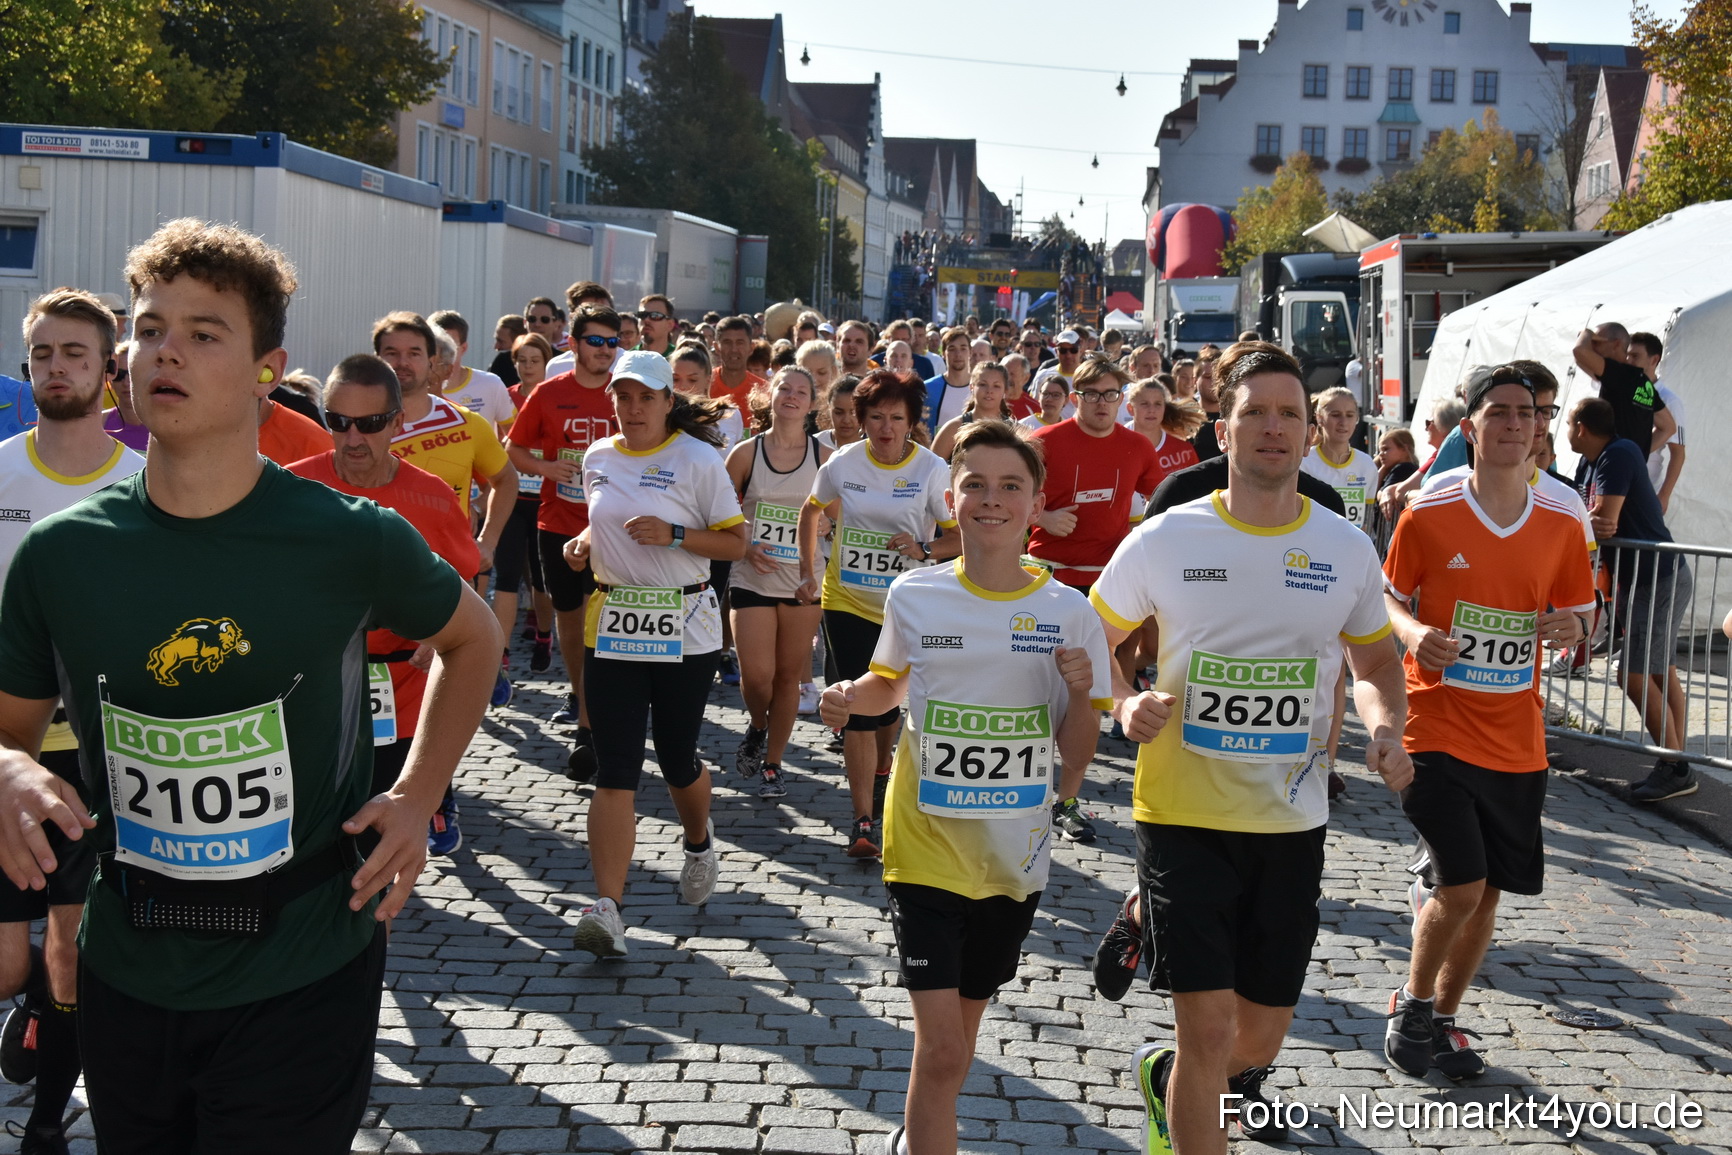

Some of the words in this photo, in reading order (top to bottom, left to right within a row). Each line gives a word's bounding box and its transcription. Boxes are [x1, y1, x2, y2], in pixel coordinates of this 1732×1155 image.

[26, 135, 40, 144] TOI
[42, 136, 56, 145] TOI
[63, 138, 81, 146] DIXI
[90, 138, 111, 147] 08141
[115, 139, 129, 148] 536
[130, 140, 139, 149] 80
[88, 147, 140, 156] www.toitoidixi.de
[977, 271, 1018, 284] START
[421, 430, 471, 451] BÖGL
[644, 467, 659, 475] 20
[638, 481, 667, 491] Stadtlauf
[640, 475, 676, 486] Neumarkter
[895, 480, 907, 488] 20
[847, 550, 904, 573] 2154
[1286, 553, 1309, 569] 20
[1311, 563, 1331, 571] JAHRE
[861, 575, 887, 586] LIBA
[1184, 569, 1227, 579] BOCK
[1285, 569, 1338, 583] Neumarkter
[1285, 580, 1328, 593] Stadtlauf
[611, 589, 674, 607] BOCK
[607, 610, 674, 636] 2046
[1012, 617, 1036, 632] 20
[1037, 624, 1060, 633] JAHRE
[1461, 608, 1537, 632] BOCK
[921, 636, 963, 645] BOCK
[1011, 633, 1064, 645] Neumarkter
[610, 640, 667, 653] KERSTIN
[1011, 644, 1054, 656] Stadtlauf
[1458, 634, 1533, 665] 2109
[1198, 658, 1304, 685] BOCK
[1465, 669, 1520, 684] NIKLAS
[1198, 691, 1301, 727] 2620
[933, 707, 1040, 735] BOCK
[114, 714, 268, 761] BOCK
[1220, 735, 1271, 750] RALF
[1040, 746, 1047, 754] D
[934, 742, 1034, 780] 2621
[274, 766, 283, 777] D
[125, 766, 271, 825] 2105
[946, 790, 1019, 805] MARCO
[150, 836, 250, 862] ANTON
[906, 956, 929, 967] Marco
